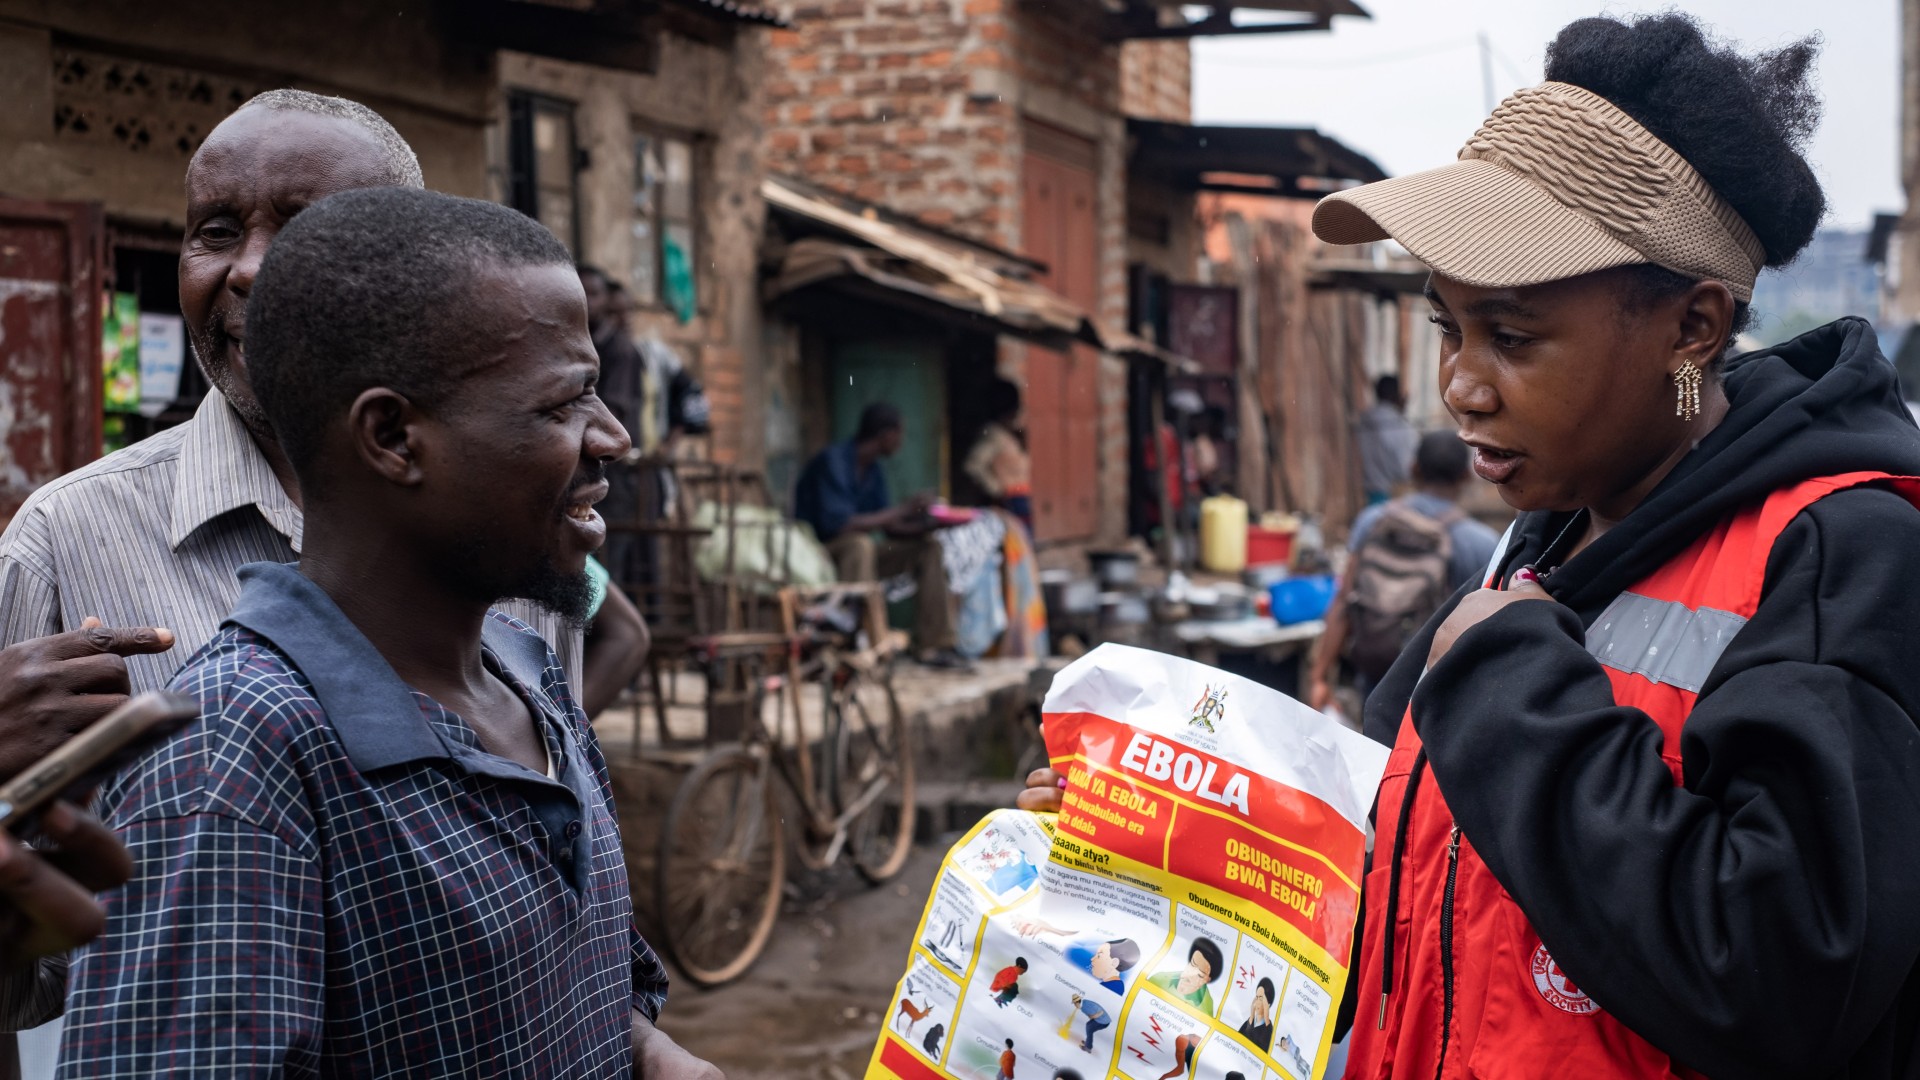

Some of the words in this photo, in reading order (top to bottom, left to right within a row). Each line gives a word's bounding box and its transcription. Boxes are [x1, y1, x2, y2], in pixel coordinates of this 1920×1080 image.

[1119, 732, 1250, 817] EBOLA
[1077, 796, 1127, 828] bwabulabe
[1127, 820, 1145, 836] era
[1091, 777, 1107, 798] YA
[1109, 785, 1158, 819] EBOLA
[1070, 814, 1097, 836] ddala
[1063, 852, 1073, 865] ku
[1083, 848, 1110, 865] atya?
[1225, 838, 1323, 899] OBUBONERO
[1057, 870, 1078, 881] agava
[1079, 876, 1092, 885] mu
[1147, 896, 1160, 907] nga
[1225, 860, 1267, 893] BWA
[1270, 879, 1316, 921] EBOLA
[1086, 905, 1106, 916] ebola
[1188, 891, 1233, 919] Obubonero
[1234, 910, 1251, 927] bwa
[1251, 920, 1274, 940] Ebola
[1270, 932, 1298, 959] bwebuno
[1297, 953, 1331, 985] wammanga:
[1543, 988, 1592, 1012] SOCIETY
